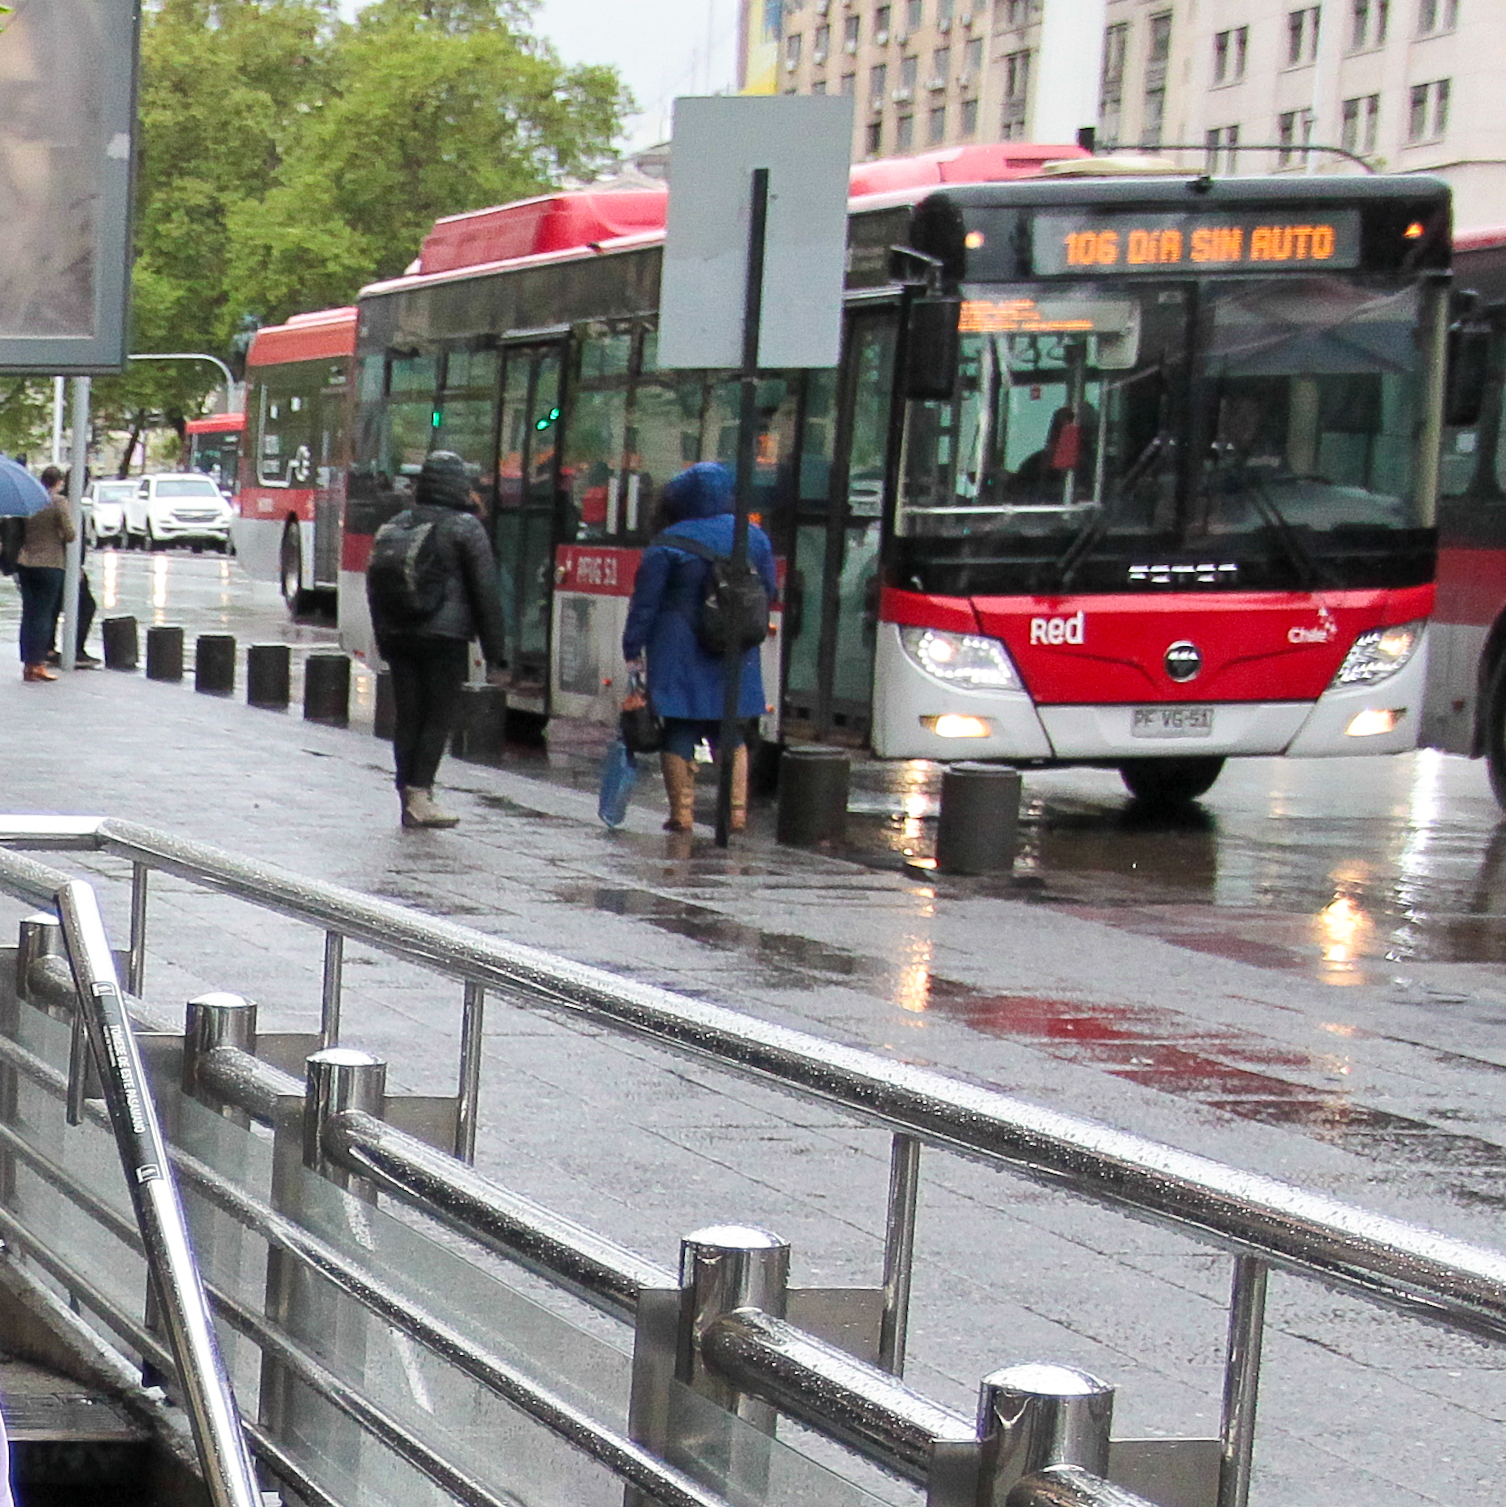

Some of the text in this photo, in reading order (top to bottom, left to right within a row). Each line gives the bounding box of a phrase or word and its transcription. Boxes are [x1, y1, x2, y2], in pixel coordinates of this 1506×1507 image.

[1064, 229, 1119, 266] 106
[1190, 226, 1244, 263] SIN
[1249, 224, 1335, 261] AUTO
[1030, 611, 1084, 645] Red
